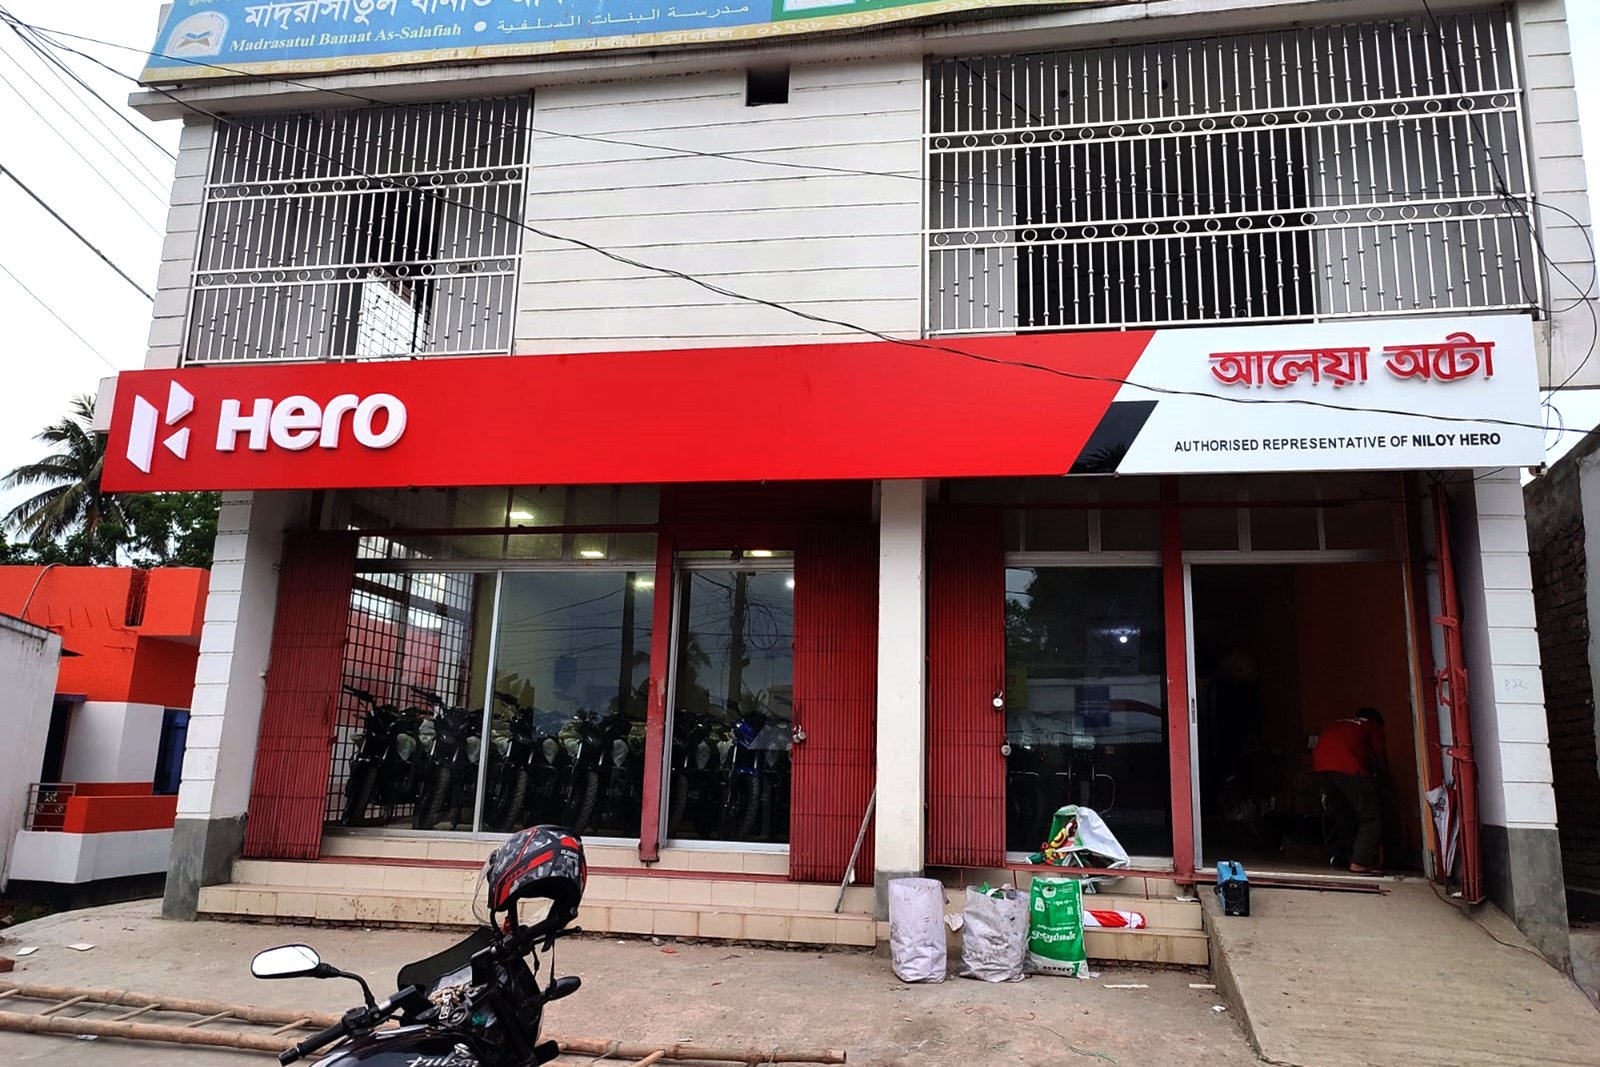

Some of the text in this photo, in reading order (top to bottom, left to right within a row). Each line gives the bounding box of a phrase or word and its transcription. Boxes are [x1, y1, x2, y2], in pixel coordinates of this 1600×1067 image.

[496, 5, 749, 34] مدرسة البنات السلفية
[229, 24, 461, 52] Madrasatul Banaat As-Salafiah
[1209, 332, 1496, 388] আলেয়া অটো
[1175, 432, 1501, 452] AUTHORISED REPRESENTATIVE OF NILOY HERO
